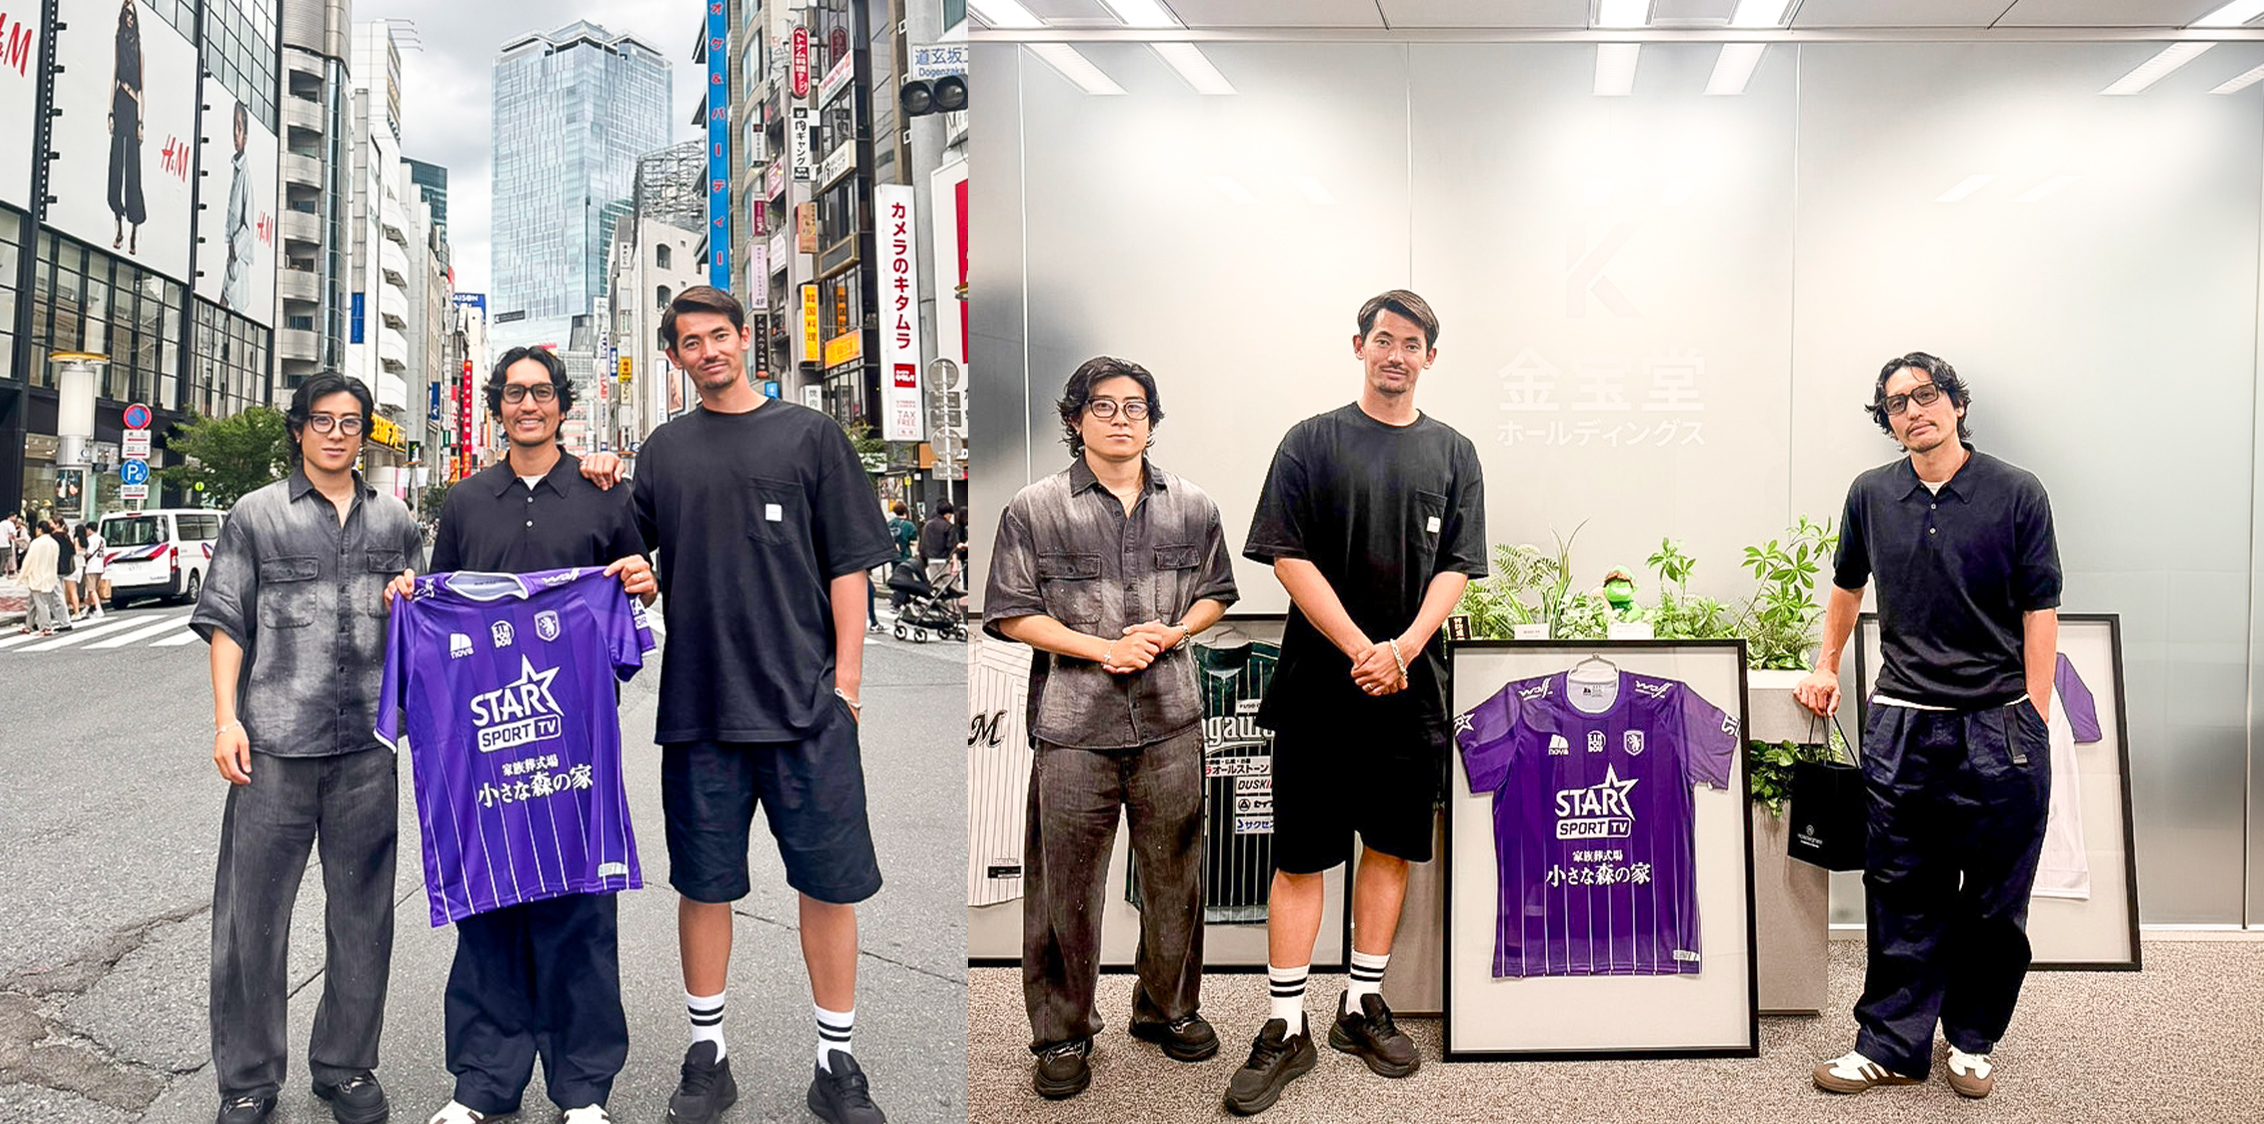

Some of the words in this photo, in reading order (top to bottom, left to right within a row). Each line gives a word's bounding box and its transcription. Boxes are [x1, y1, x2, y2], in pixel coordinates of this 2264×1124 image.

[161, 133, 190, 183] H&M
[256, 210, 274, 249] H&M
[891, 202, 912, 350] カメラのキタムラ
[453, 294, 479, 302] AISON
[897, 410, 916, 420] TAX
[1496, 418, 1706, 448] ホールディングス
[482, 723, 532, 748] SPORT
[537, 719, 556, 735] TV
[502, 753, 559, 777] 家族葬式場
[478, 764, 594, 809] 小さな森の家
[1560, 821, 1606, 836] SPORT
[1611, 822, 1628, 833] TV
[1572, 850, 1624, 862] 家族葬式場
[1546, 862, 1651, 888] 小さな森の家
